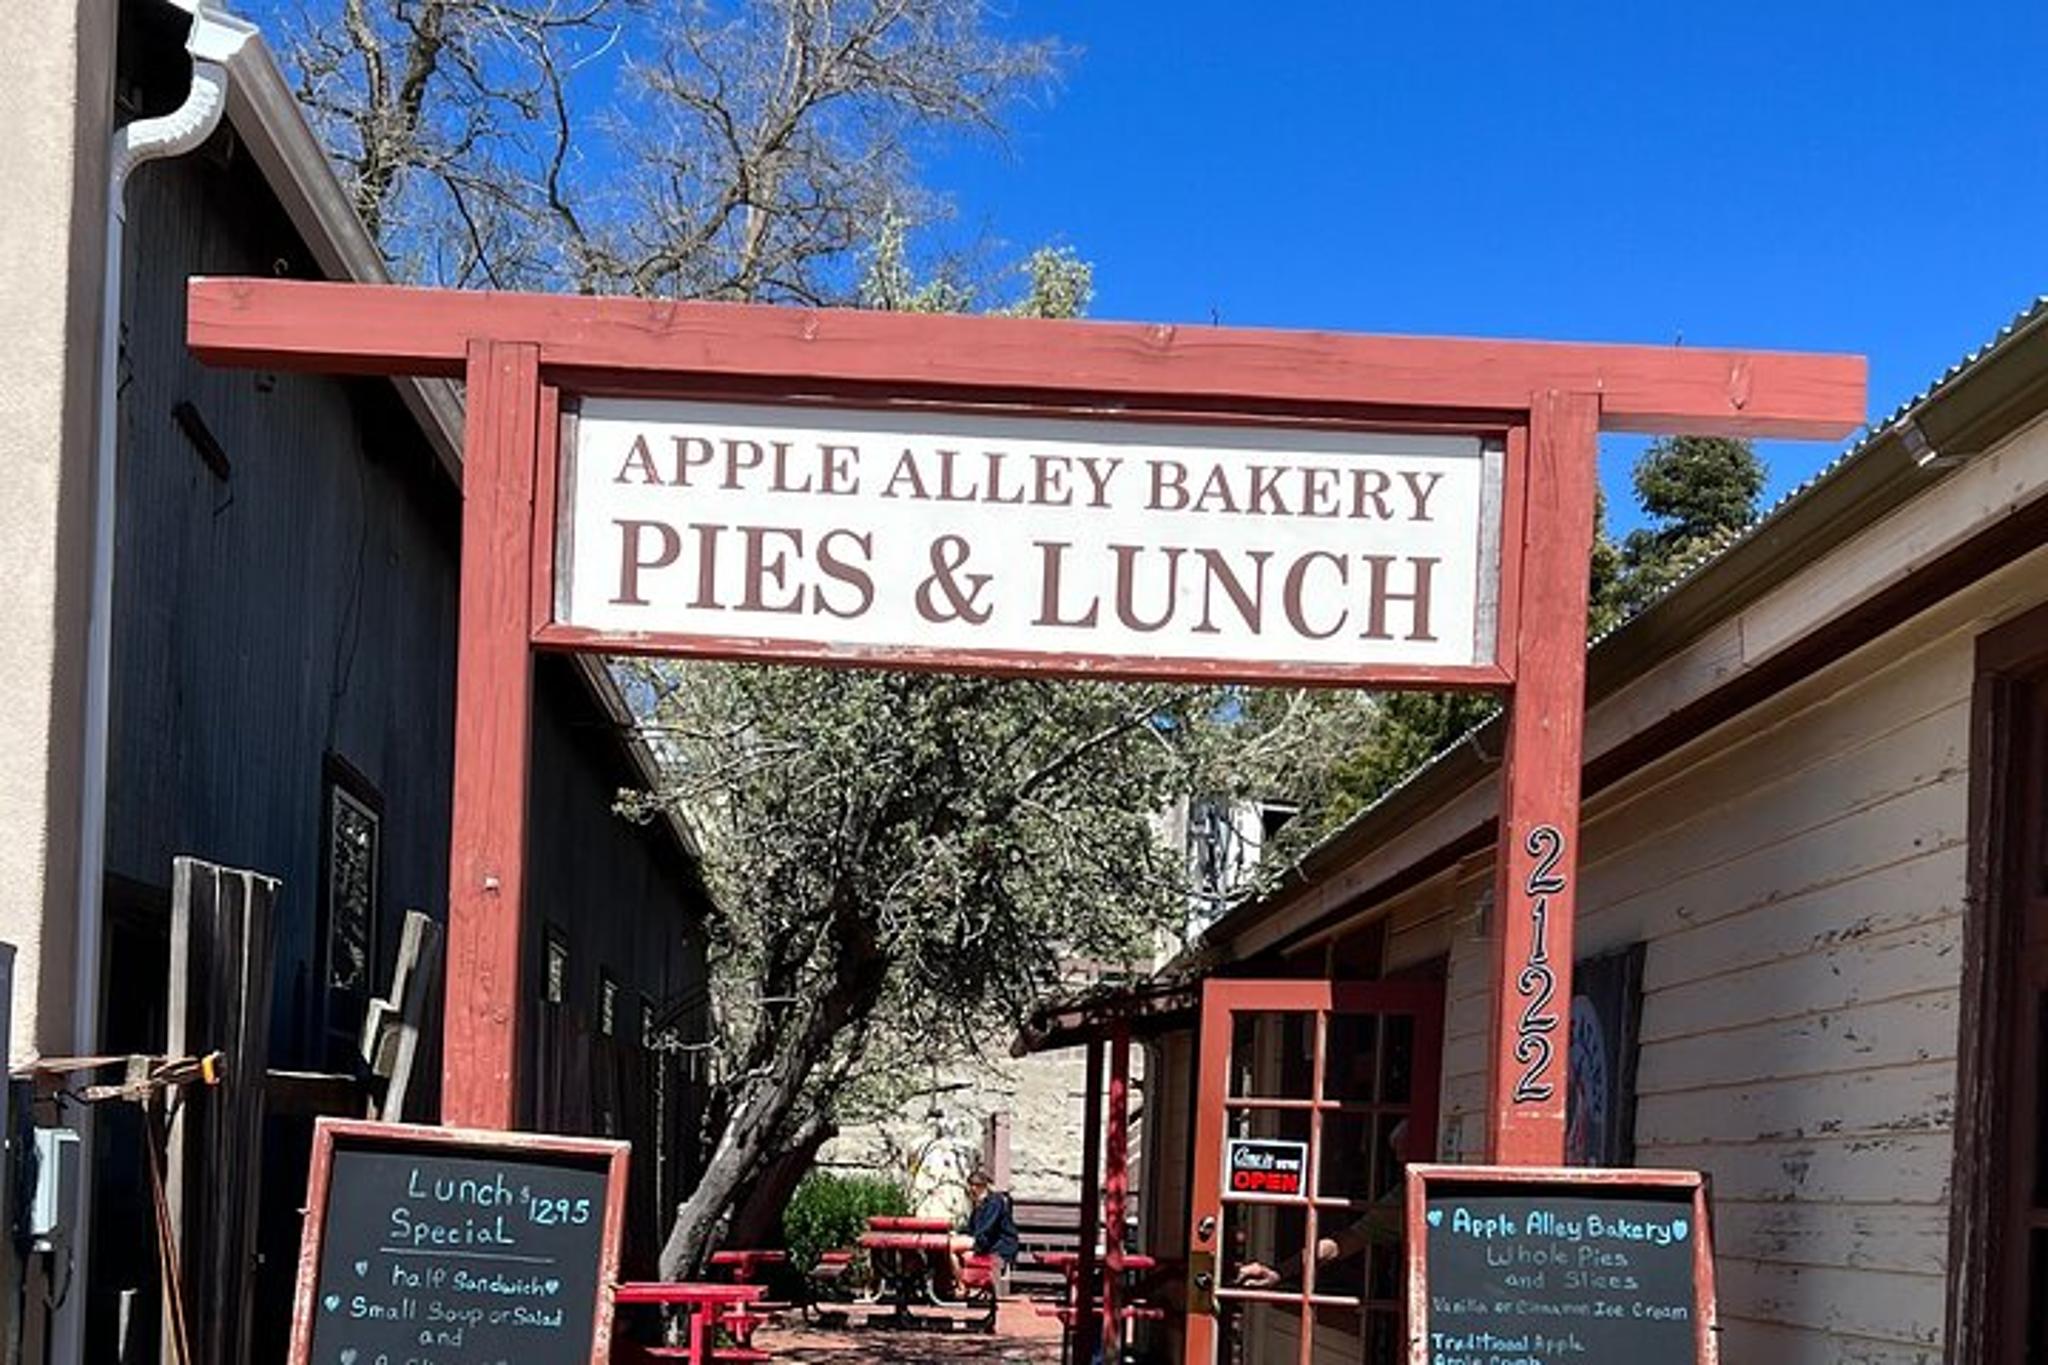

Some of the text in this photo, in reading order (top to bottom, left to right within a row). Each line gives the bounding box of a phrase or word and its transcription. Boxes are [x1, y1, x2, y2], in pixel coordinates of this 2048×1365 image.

[614, 434, 1445, 522] APPLE ALLEY BAKERY
[608, 517, 1440, 643] PIES & LUNCH
[1513, 825, 1565, 1103] 2122
[408, 1168, 513, 1206] Lunch
[1234, 1170, 1298, 1193] OPEN
[1452, 1207, 1671, 1245] Apple Alley Bakery
[1487, 1244, 1629, 1267] Whole Pies
[453, 1270, 546, 1297] Sandwich
[1504, 1270, 1639, 1290] and Slices
[350, 1296, 417, 1319] Small
[427, 1300, 485, 1328] Soup
[488, 1309, 513, 1325] or
[1631, 1301, 1688, 1320] Cream
[418, 1328, 464, 1348] and
